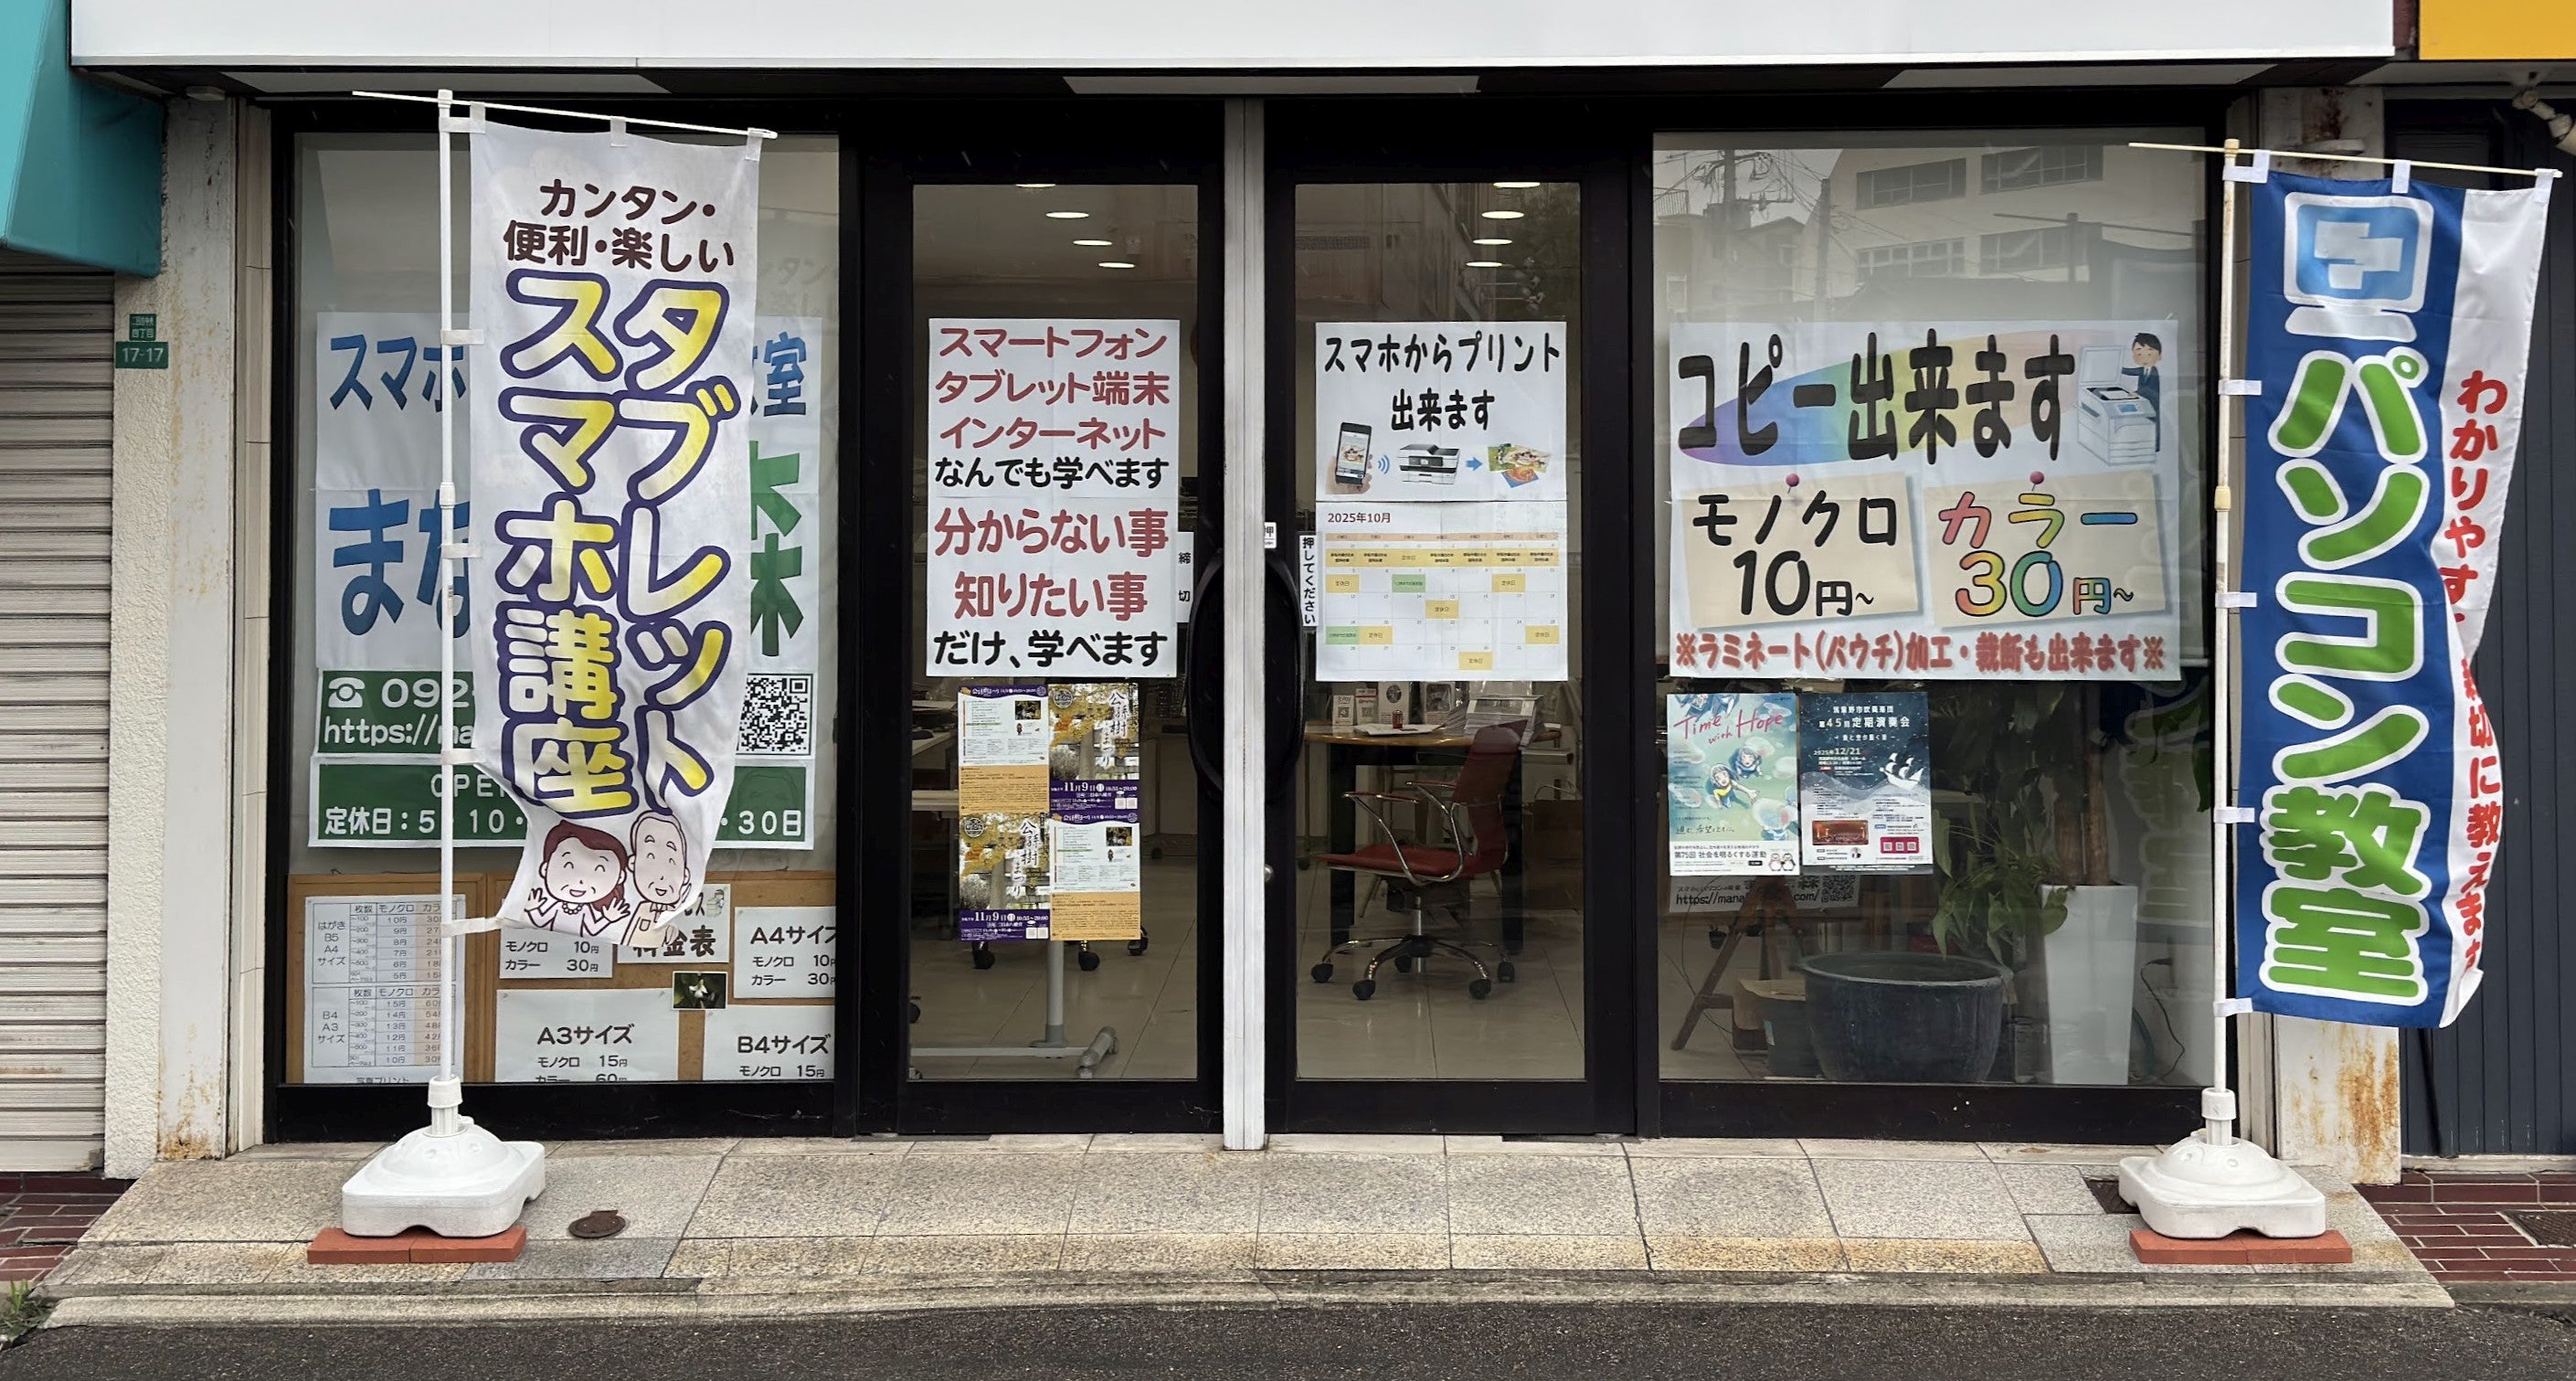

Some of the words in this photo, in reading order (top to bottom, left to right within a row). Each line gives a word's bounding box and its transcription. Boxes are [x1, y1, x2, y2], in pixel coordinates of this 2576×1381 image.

[539, 179, 716, 224] カンタン・
[504, 220, 734, 272] 便利・楽しい
[939, 325, 1168, 360] スマートフォン
[1324, 330, 1561, 374] スマホからプリント
[122, 347, 164, 362] 17-17
[935, 368, 1170, 406] タブレット端末
[1678, 328, 2075, 465] コピー出来ます
[1391, 388, 1496, 432] 出来ます
[939, 417, 1166, 451] インターネット
[935, 456, 1170, 489] なんでも学べます
[1328, 512, 1392, 524] 2025年10月
[1692, 490, 1898, 548] モノクロ
[1938, 491, 2138, 549] カラー
[495, 269, 639, 818] スマホ講座
[934, 507, 1169, 558] 分からない事
[612, 278, 741, 813] タブレット
[1302, 536, 1316, 624] 押してください
[954, 571, 1148, 621] 知りたい事
[933, 630, 1168, 668] だけ、学べます
[2259, 346, 2433, 1006] パソコン教室
[1673, 715, 1722, 739] Time
[1735, 708, 1784, 738] Hope
[1708, 726, 1733, 745] with
[355, 905, 373, 913] 枚数
[378, 904, 415, 912] モノクロ
[422, 904, 440, 912] カラ
[317, 921, 345, 930] はがき
[323, 945, 339, 953] A4
[324, 933, 339, 942] B5
[505, 941, 547, 952] モノクロ
[574, 940, 599, 954] 10円
[317, 957, 345, 966] サイズ
[505, 960, 541, 972] カラー
[566, 960, 599, 972] 30円
[752, 955, 794, 967] モノクロ
[751, 974, 787, 986] カラー
[354, 988, 372, 997] 枚数
[378, 988, 414, 996] モノクロ
[421, 987, 440, 996] カラ
[322, 1023, 339, 1031] A3
[536, 1023, 635, 1045] A3サイズ
[317, 1034, 345, 1044] サイズ
[737, 1033, 832, 1056] B4サイズ
[537, 1056, 580, 1068] モノクロ
[599, 1055, 628, 1068] 15円
[739, 1066, 781, 1078] モノクロ
[796, 1065, 825, 1078] 15円
